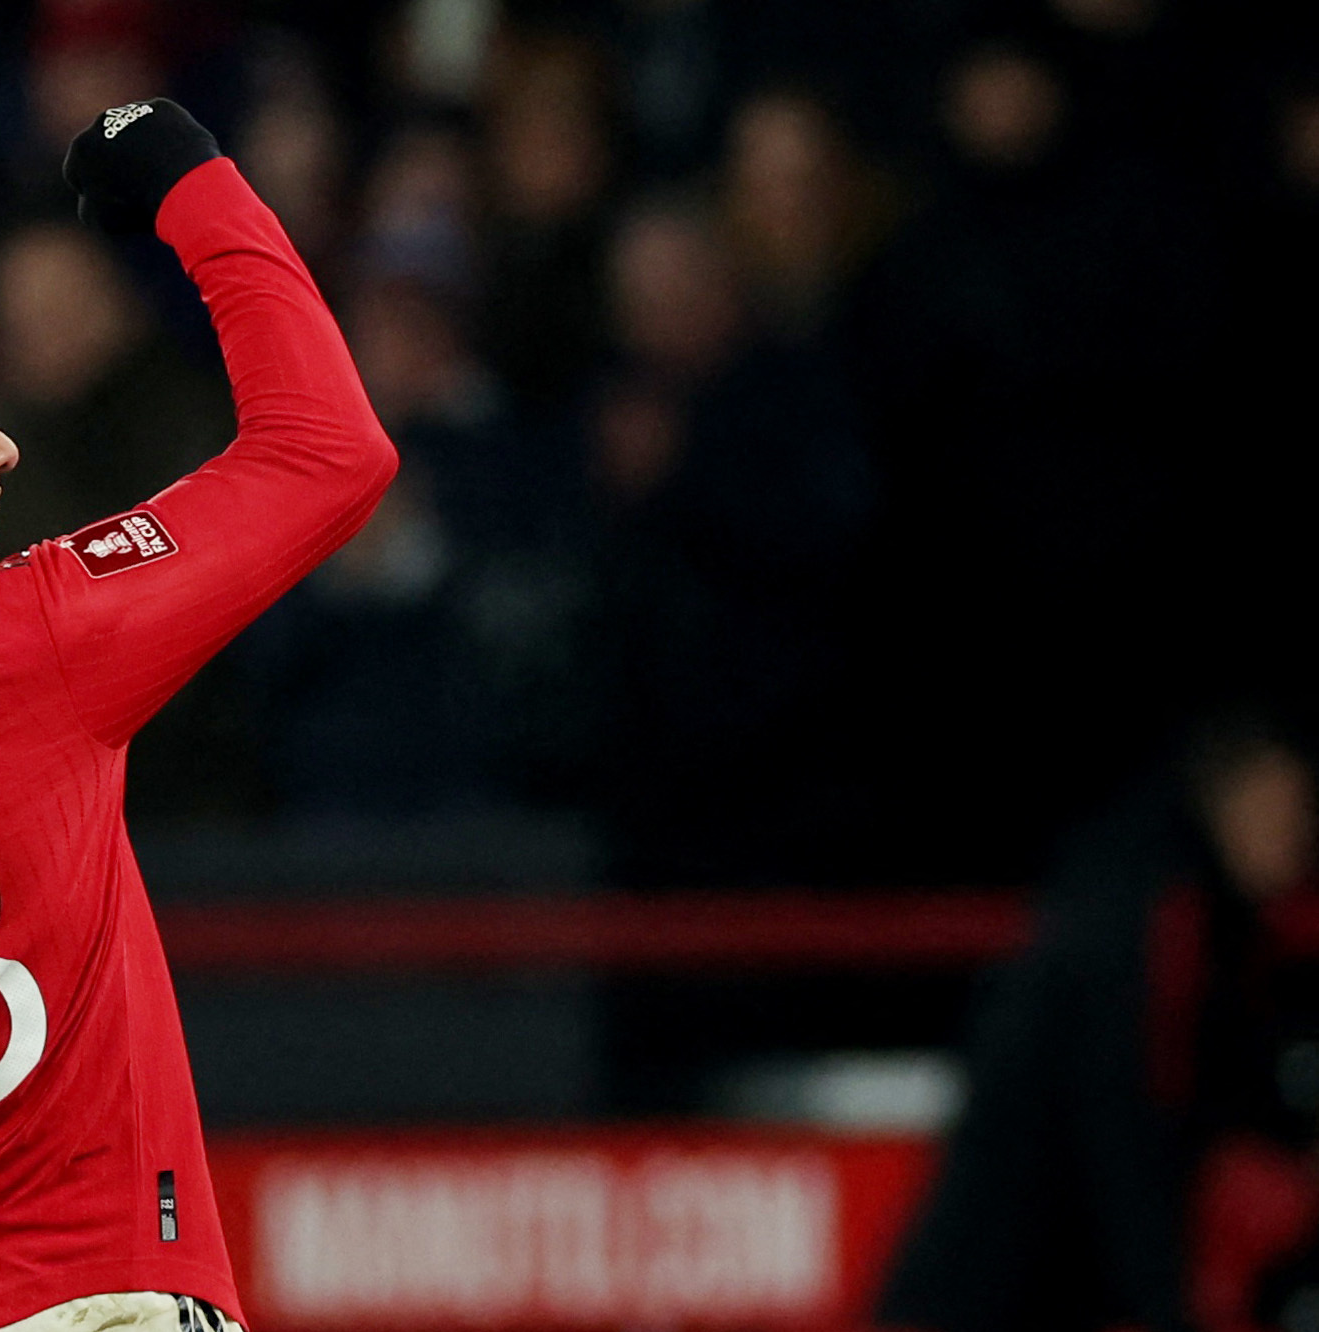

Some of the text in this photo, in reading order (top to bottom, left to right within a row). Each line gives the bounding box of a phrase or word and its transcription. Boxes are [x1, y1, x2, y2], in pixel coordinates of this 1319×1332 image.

[120, 519, 154, 557] Emirates
[131, 516, 168, 553] FA CUP
